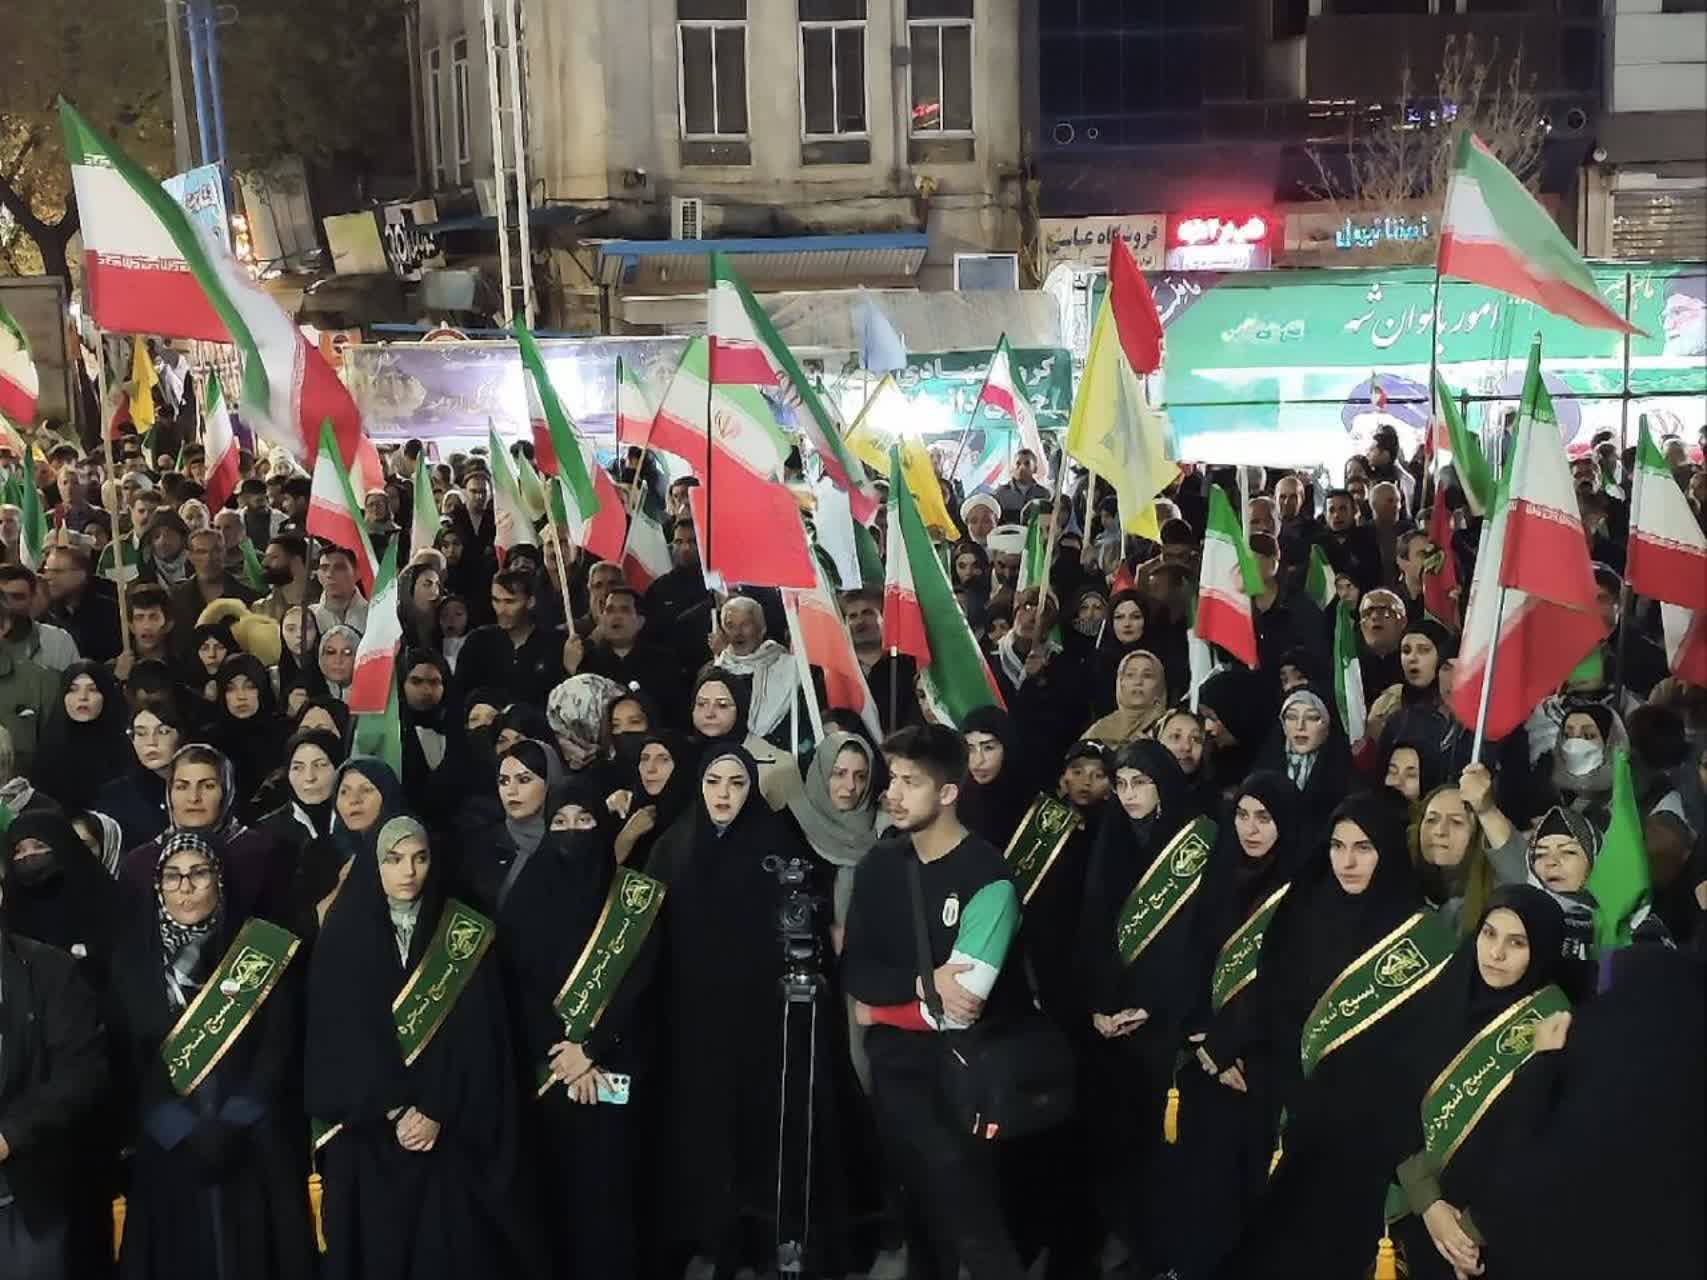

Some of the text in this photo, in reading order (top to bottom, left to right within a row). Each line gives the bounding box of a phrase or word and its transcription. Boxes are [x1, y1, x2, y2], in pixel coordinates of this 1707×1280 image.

[1096, 219, 1159, 250] فروشگاه
[1370, 283, 1448, 354] بانوان
[1448, 301, 1501, 334] امور
[1123, 877, 1179, 935] بسیج شجره
[608, 917, 636, 955] بسیج
[585, 948, 612, 989] شجره
[397, 963, 460, 1036] بسیج شجره
[1338, 983, 1380, 1017] بسیج
[173, 995, 242, 1070] بسیج شجره
[1433, 1055, 1501, 1131] بسیج شجره
